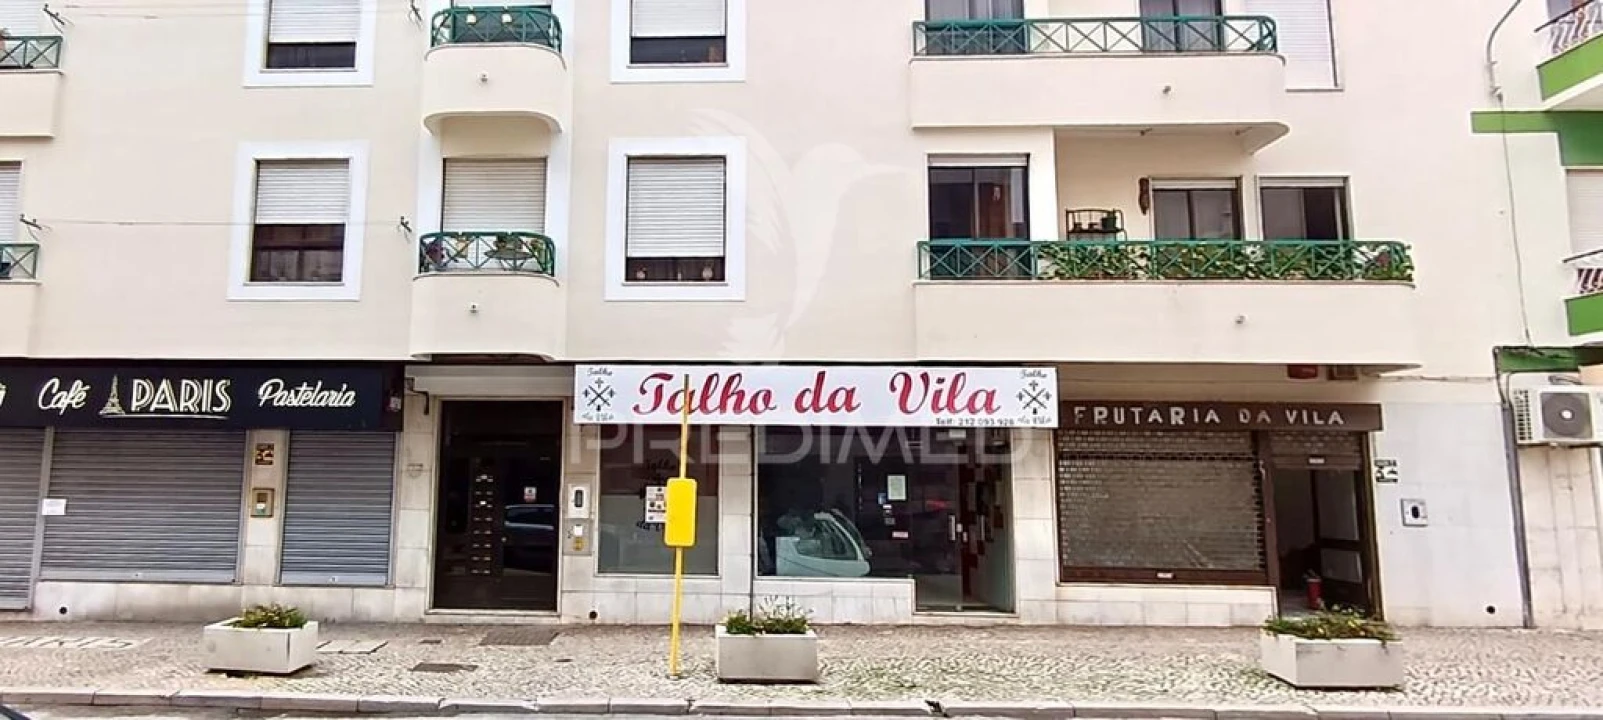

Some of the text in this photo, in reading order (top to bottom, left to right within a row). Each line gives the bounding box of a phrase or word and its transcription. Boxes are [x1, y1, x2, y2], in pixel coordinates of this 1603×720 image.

[38, 378, 91, 416] Café
[131, 379, 231, 413] PARIS
[258, 378, 356, 408] Pastelaria
[632, 371, 1001, 415] Talho da Vila
[1073, 406, 1344, 425] FRUTARIA DA VILA
